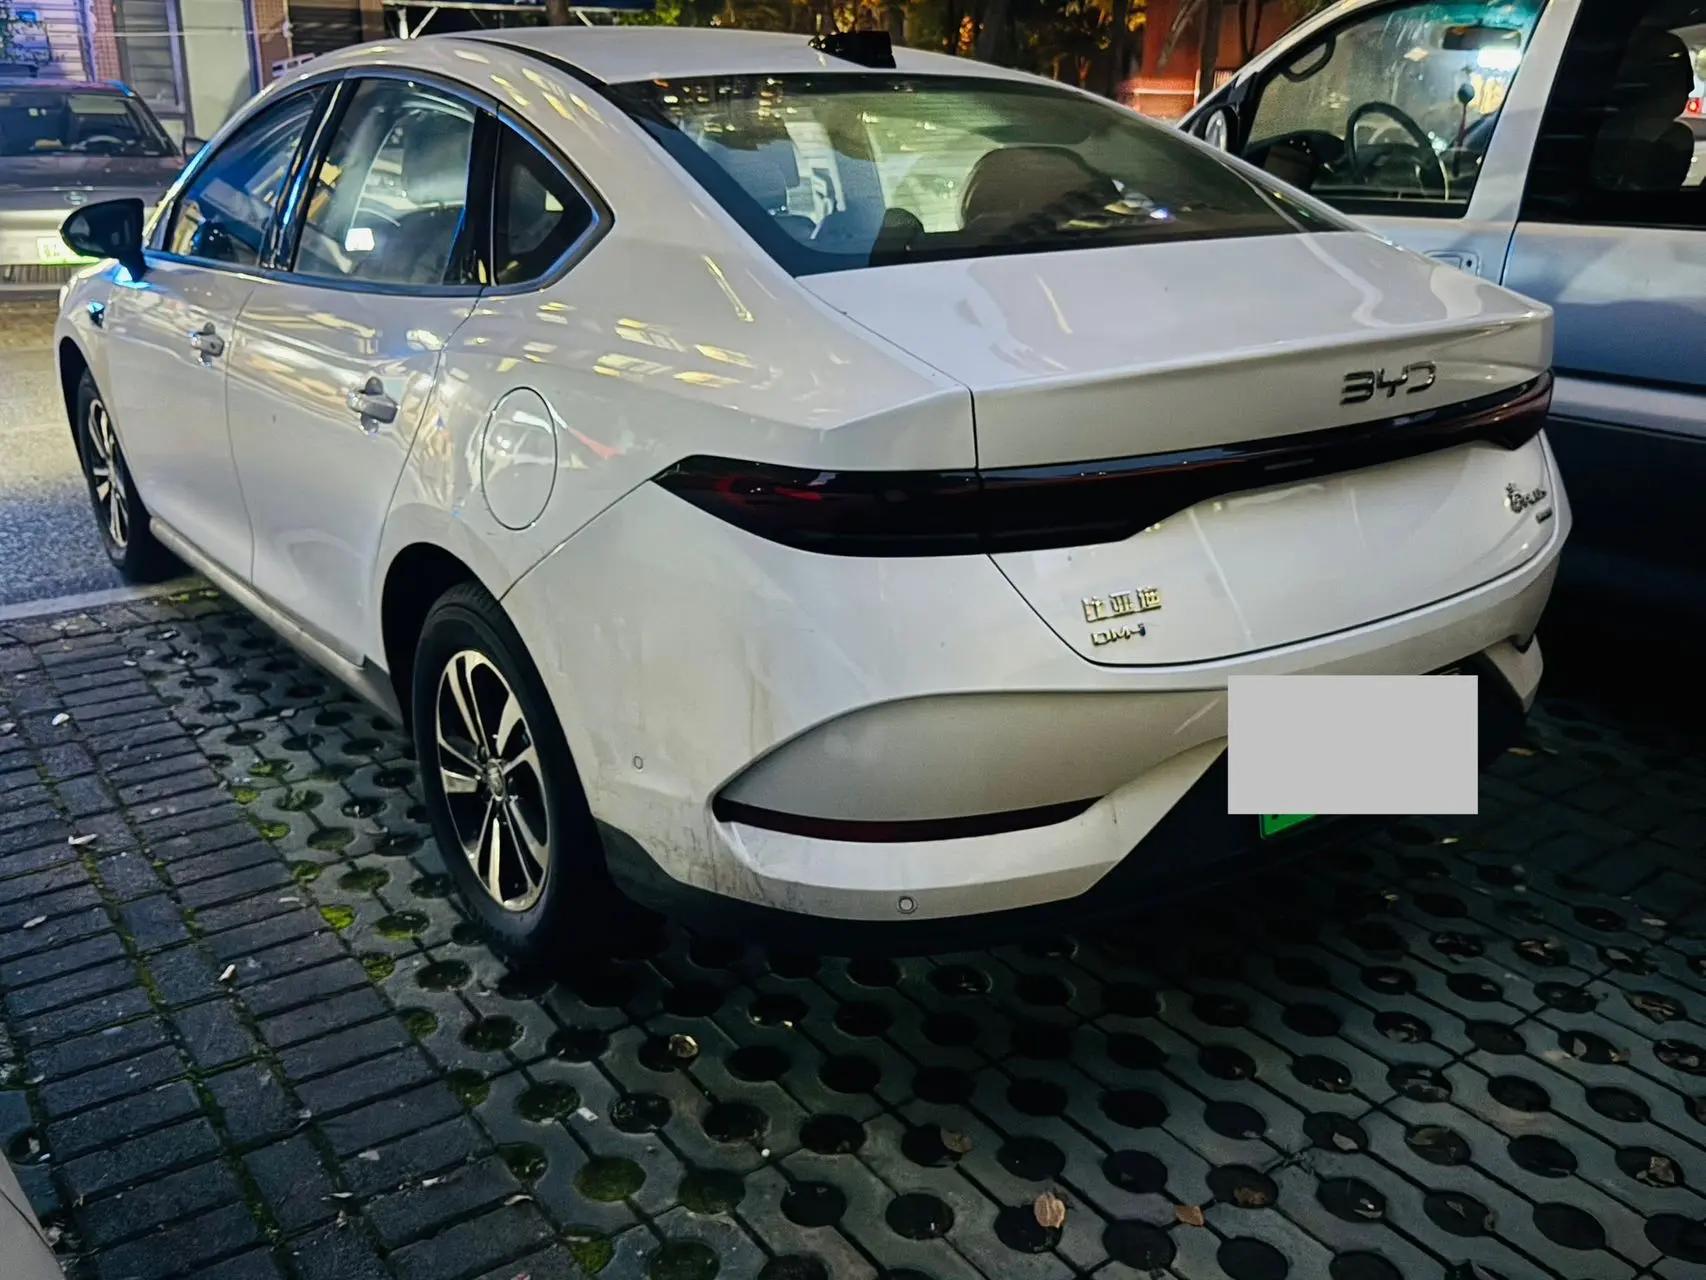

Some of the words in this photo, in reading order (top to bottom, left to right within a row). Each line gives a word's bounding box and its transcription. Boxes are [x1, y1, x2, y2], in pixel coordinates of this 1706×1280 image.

[1340, 360, 1436, 405] BYD
[1082, 586, 1162, 623] 比亚迪
